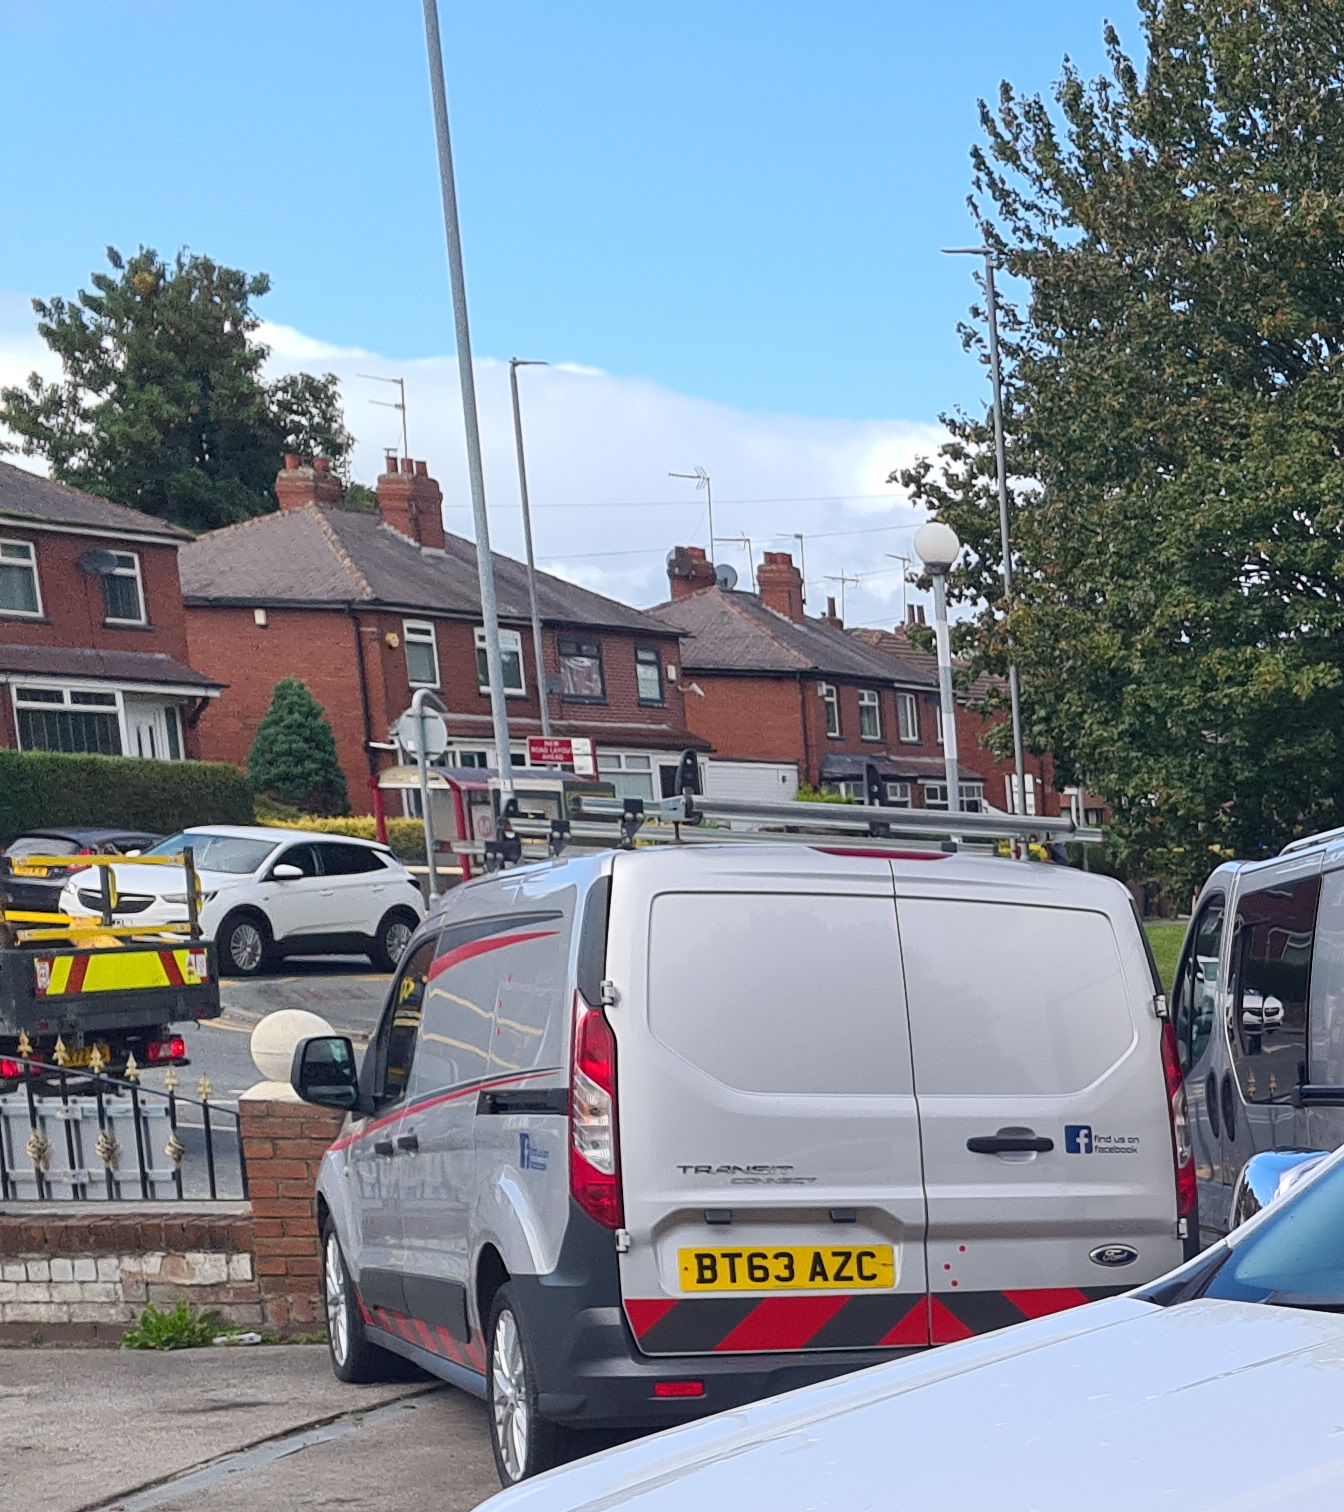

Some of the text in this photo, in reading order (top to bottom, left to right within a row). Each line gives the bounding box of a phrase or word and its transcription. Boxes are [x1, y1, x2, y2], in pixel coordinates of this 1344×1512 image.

[1094, 1134, 1140, 1144] find us on
[1094, 1145, 1138, 1154] facebook
[676, 1164, 794, 1176] TRANSIT
[730, 1176, 818, 1185] CONNECT
[693, 1250, 878, 1285] BT63 AZC
